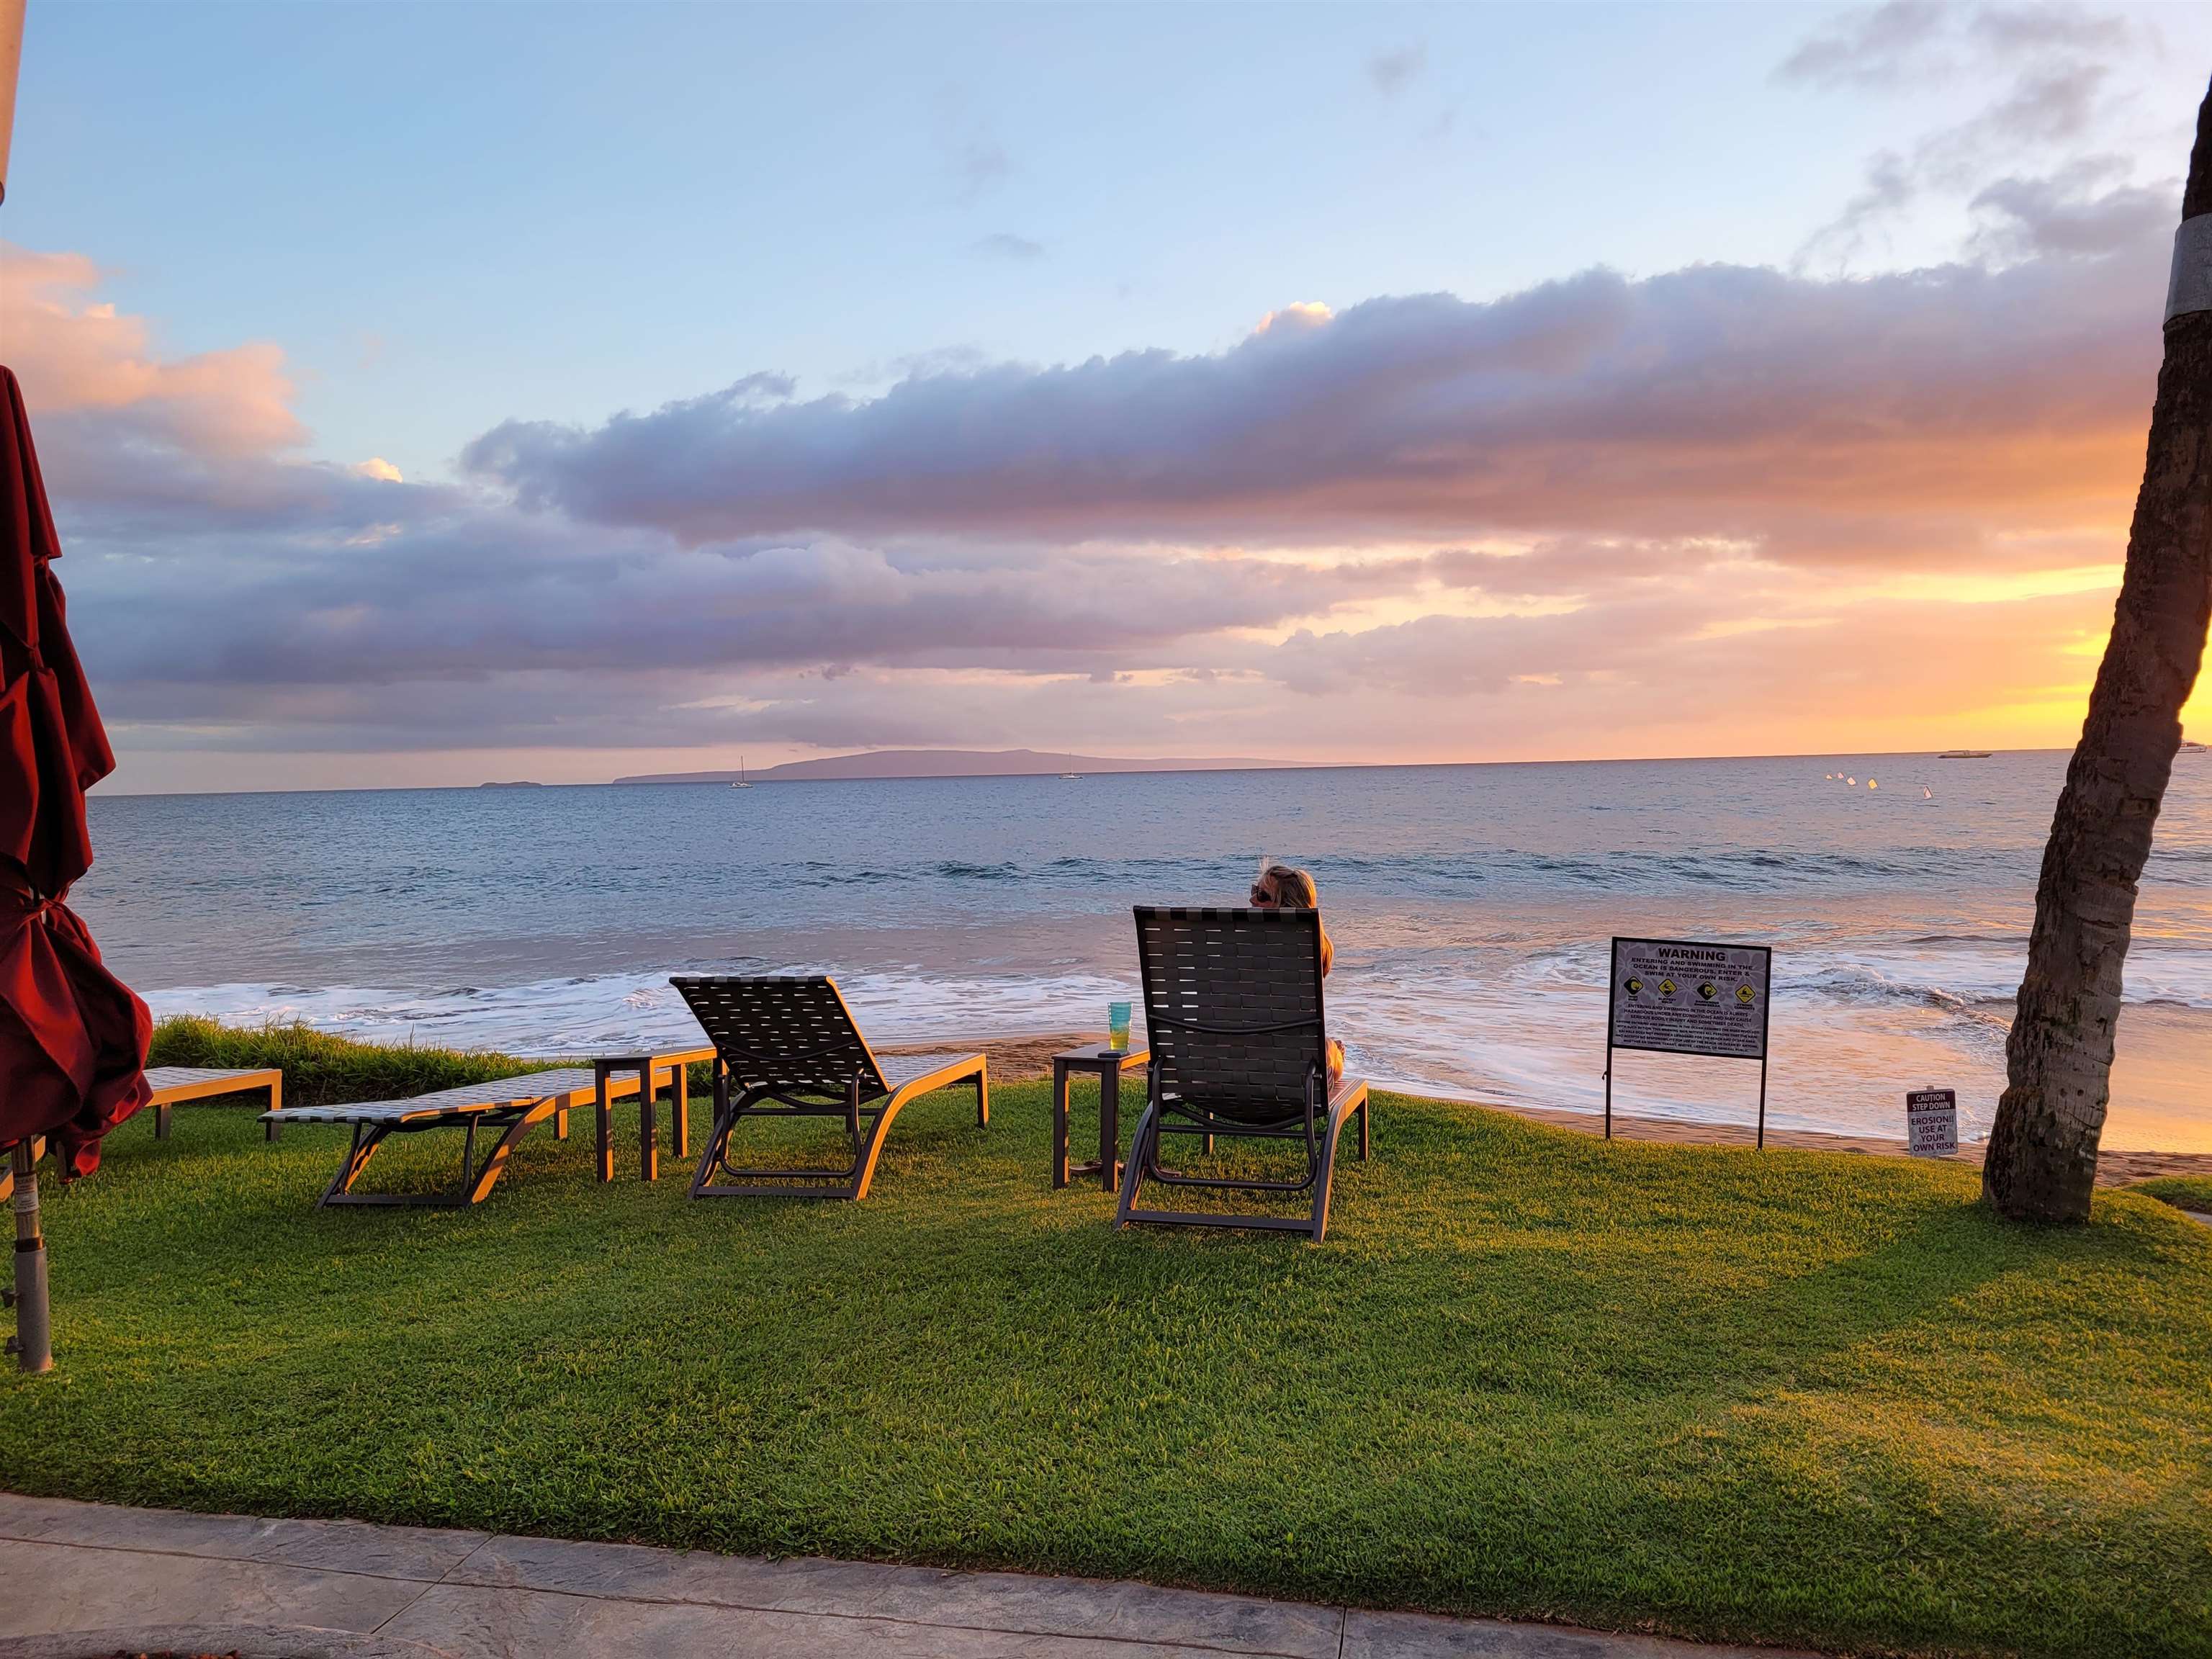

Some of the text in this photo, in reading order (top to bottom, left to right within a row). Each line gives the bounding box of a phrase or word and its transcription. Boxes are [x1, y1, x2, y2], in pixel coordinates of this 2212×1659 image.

[1658, 948, 1725, 961] WARNING
[1916, 1094, 1946, 1102] CAUTION
[1912, 1116, 1954, 1125] EROSION!!
